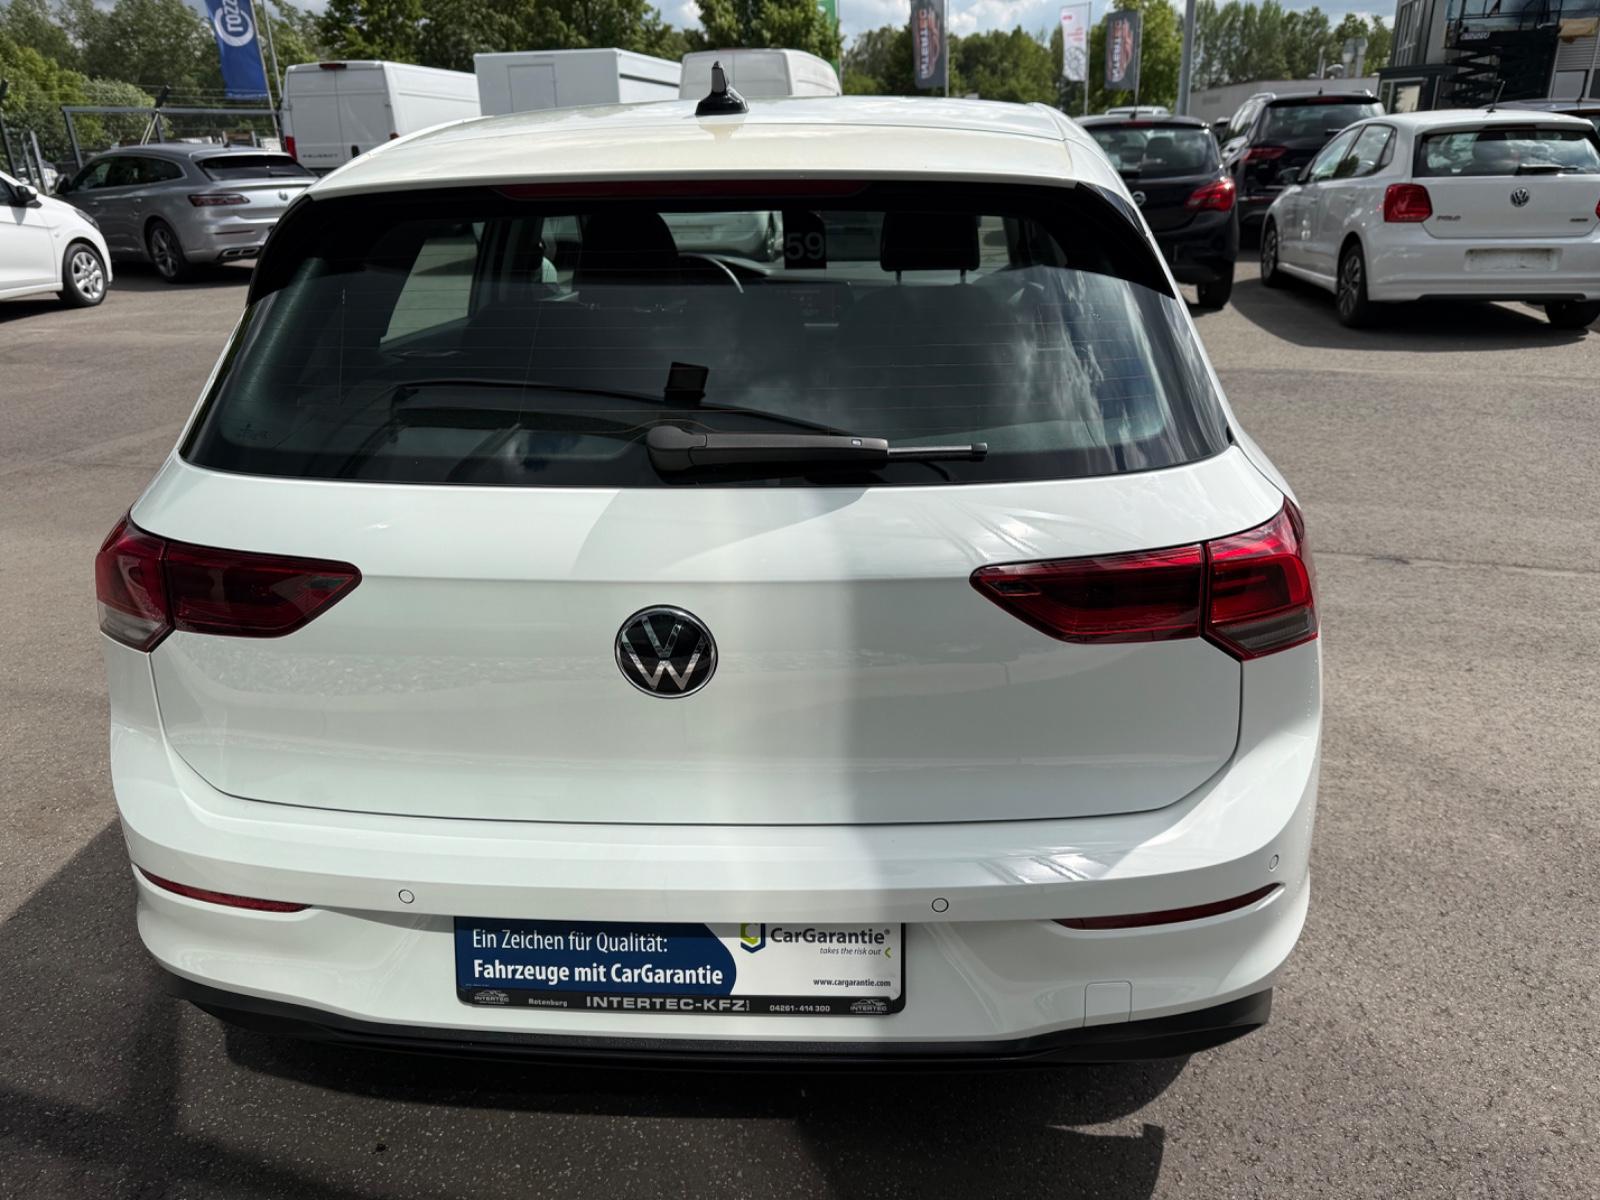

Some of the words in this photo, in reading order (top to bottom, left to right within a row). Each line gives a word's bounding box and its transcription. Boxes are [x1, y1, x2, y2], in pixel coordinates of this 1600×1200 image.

[785, 232, 825, 260] 59
[473, 929, 497, 948] Ein
[501, 929, 564, 950] Zeichen
[568, 931, 592, 951] für
[596, 931, 668, 953] Qualität:
[819, 947, 840, 955] takes
[854, 948, 867, 956] risk
[473, 959, 570, 986] Fahrzeuge
[574, 962, 607, 982] mit
[610, 963, 724, 985] CarGarantie
[813, 978, 891, 987] www.cargarantie.com
[528, 998, 568, 1008] Rotenburg
[586, 996, 745, 1011] INTERTEC-KFZ
